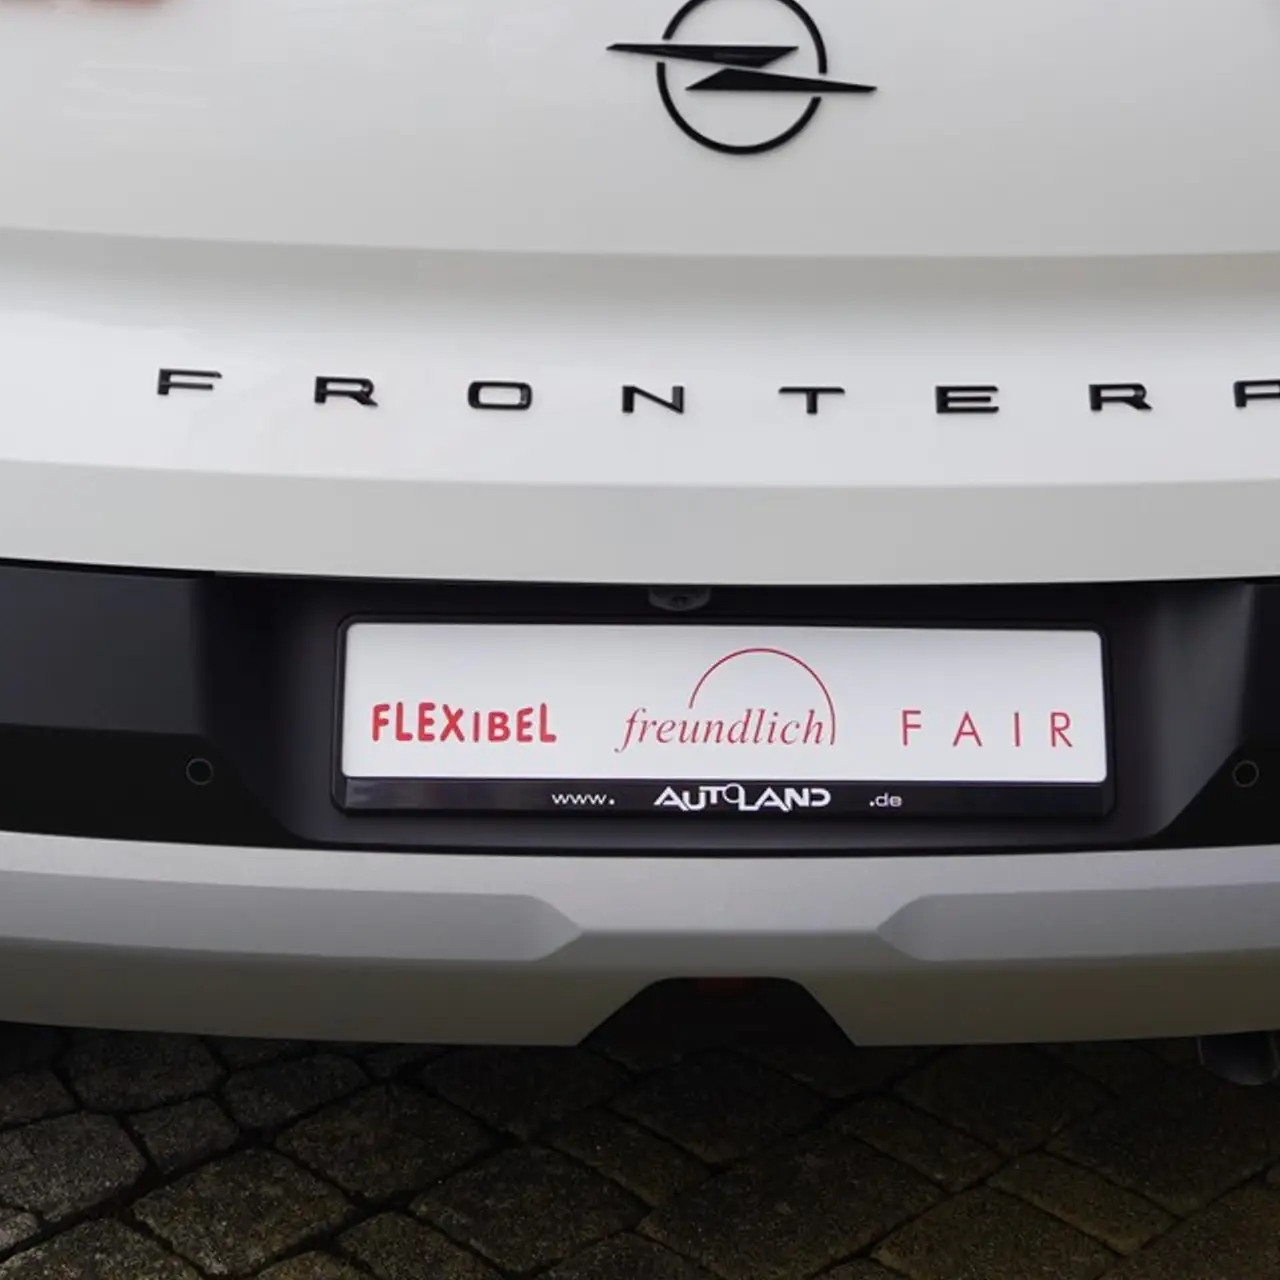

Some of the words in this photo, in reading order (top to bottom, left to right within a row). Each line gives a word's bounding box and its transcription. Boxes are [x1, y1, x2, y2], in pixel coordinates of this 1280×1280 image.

[371, 701, 557, 743] FLEXIBEL
[614, 707, 824, 753] freundlich
[901, 710, 1072, 747] FAIR
[552, 793, 615, 805] www.
[653, 783, 832, 812] AUTOLAND
[869, 793, 903, 808] .de
